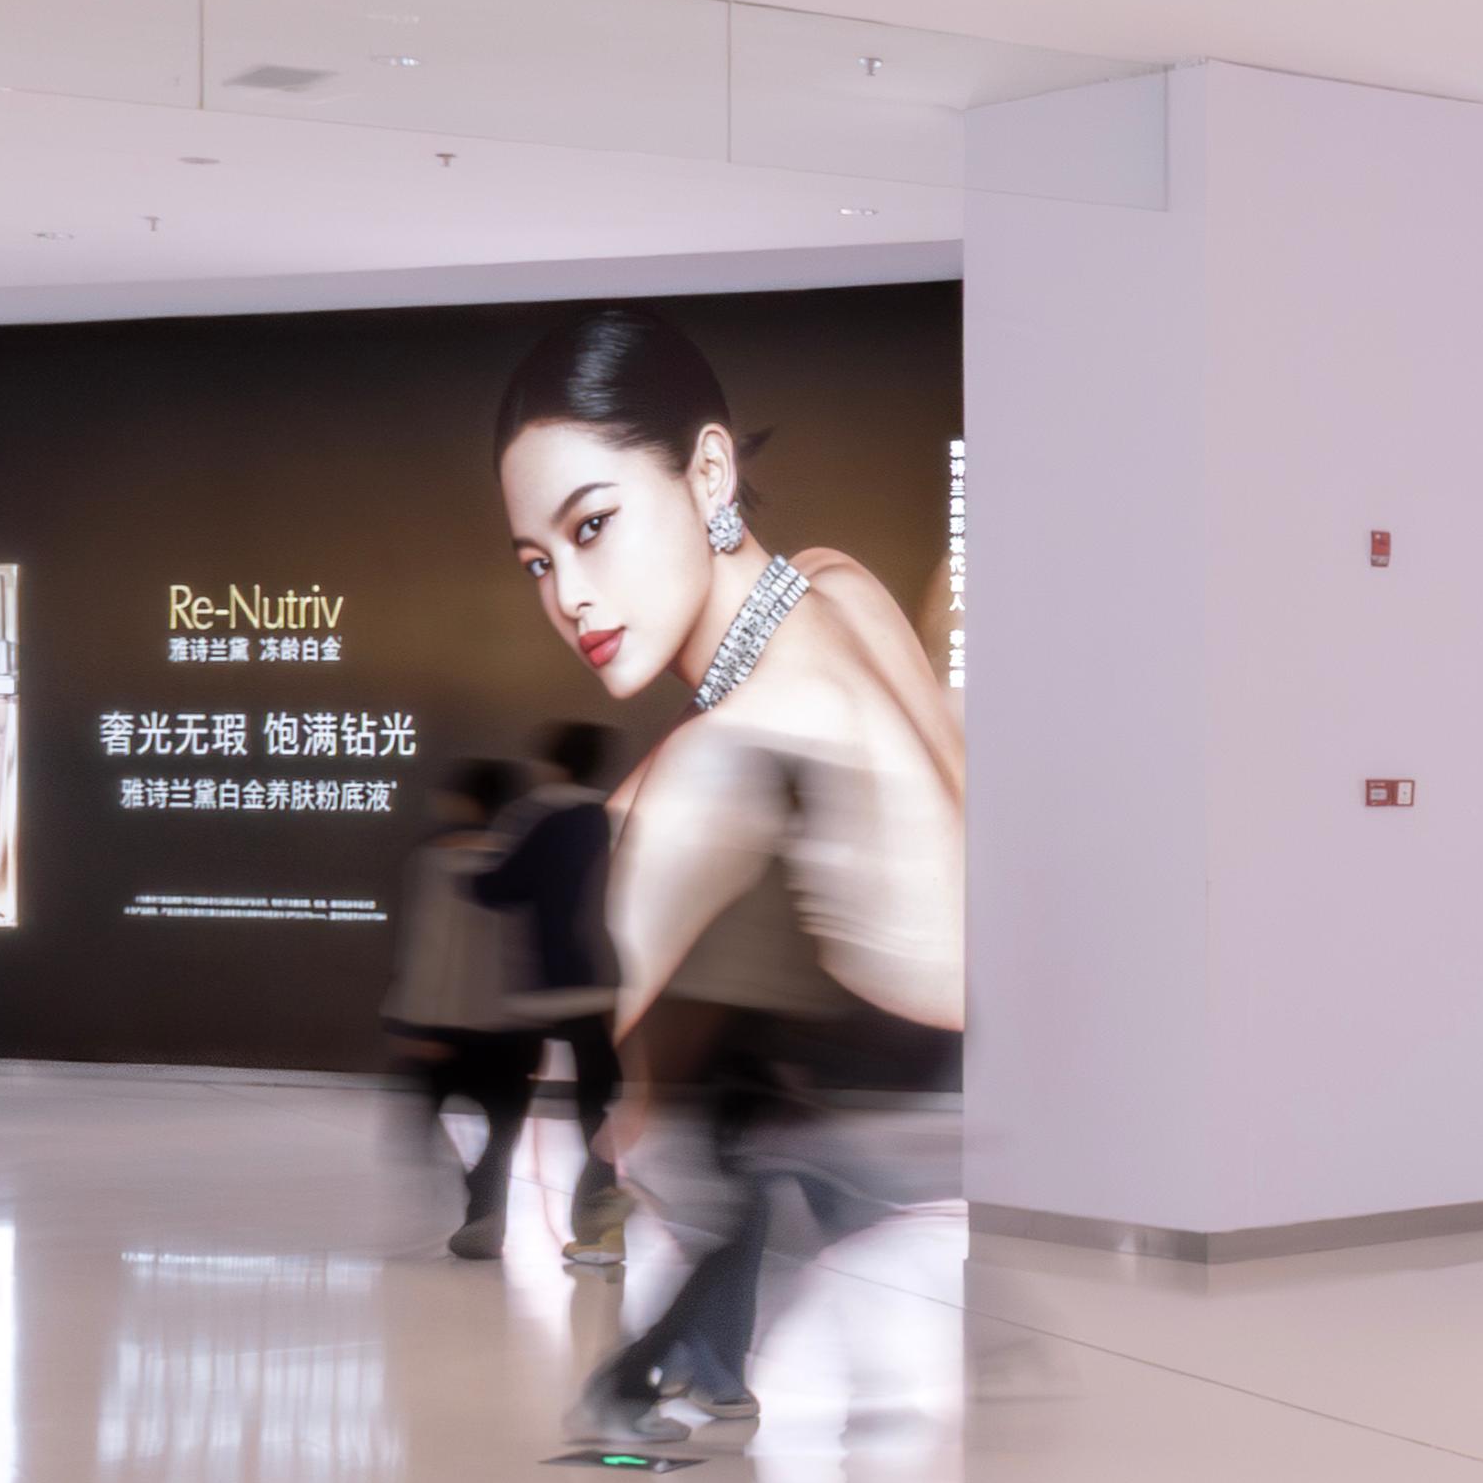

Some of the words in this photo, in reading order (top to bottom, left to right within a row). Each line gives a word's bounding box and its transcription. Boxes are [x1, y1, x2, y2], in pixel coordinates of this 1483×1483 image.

[169, 583, 345, 630] Re-Nutriv
[168, 636, 250, 663] 雅诗兰黛
[99, 710, 249, 757] 奢光无瑕
[263, 711, 418, 757] 饱满钻光
